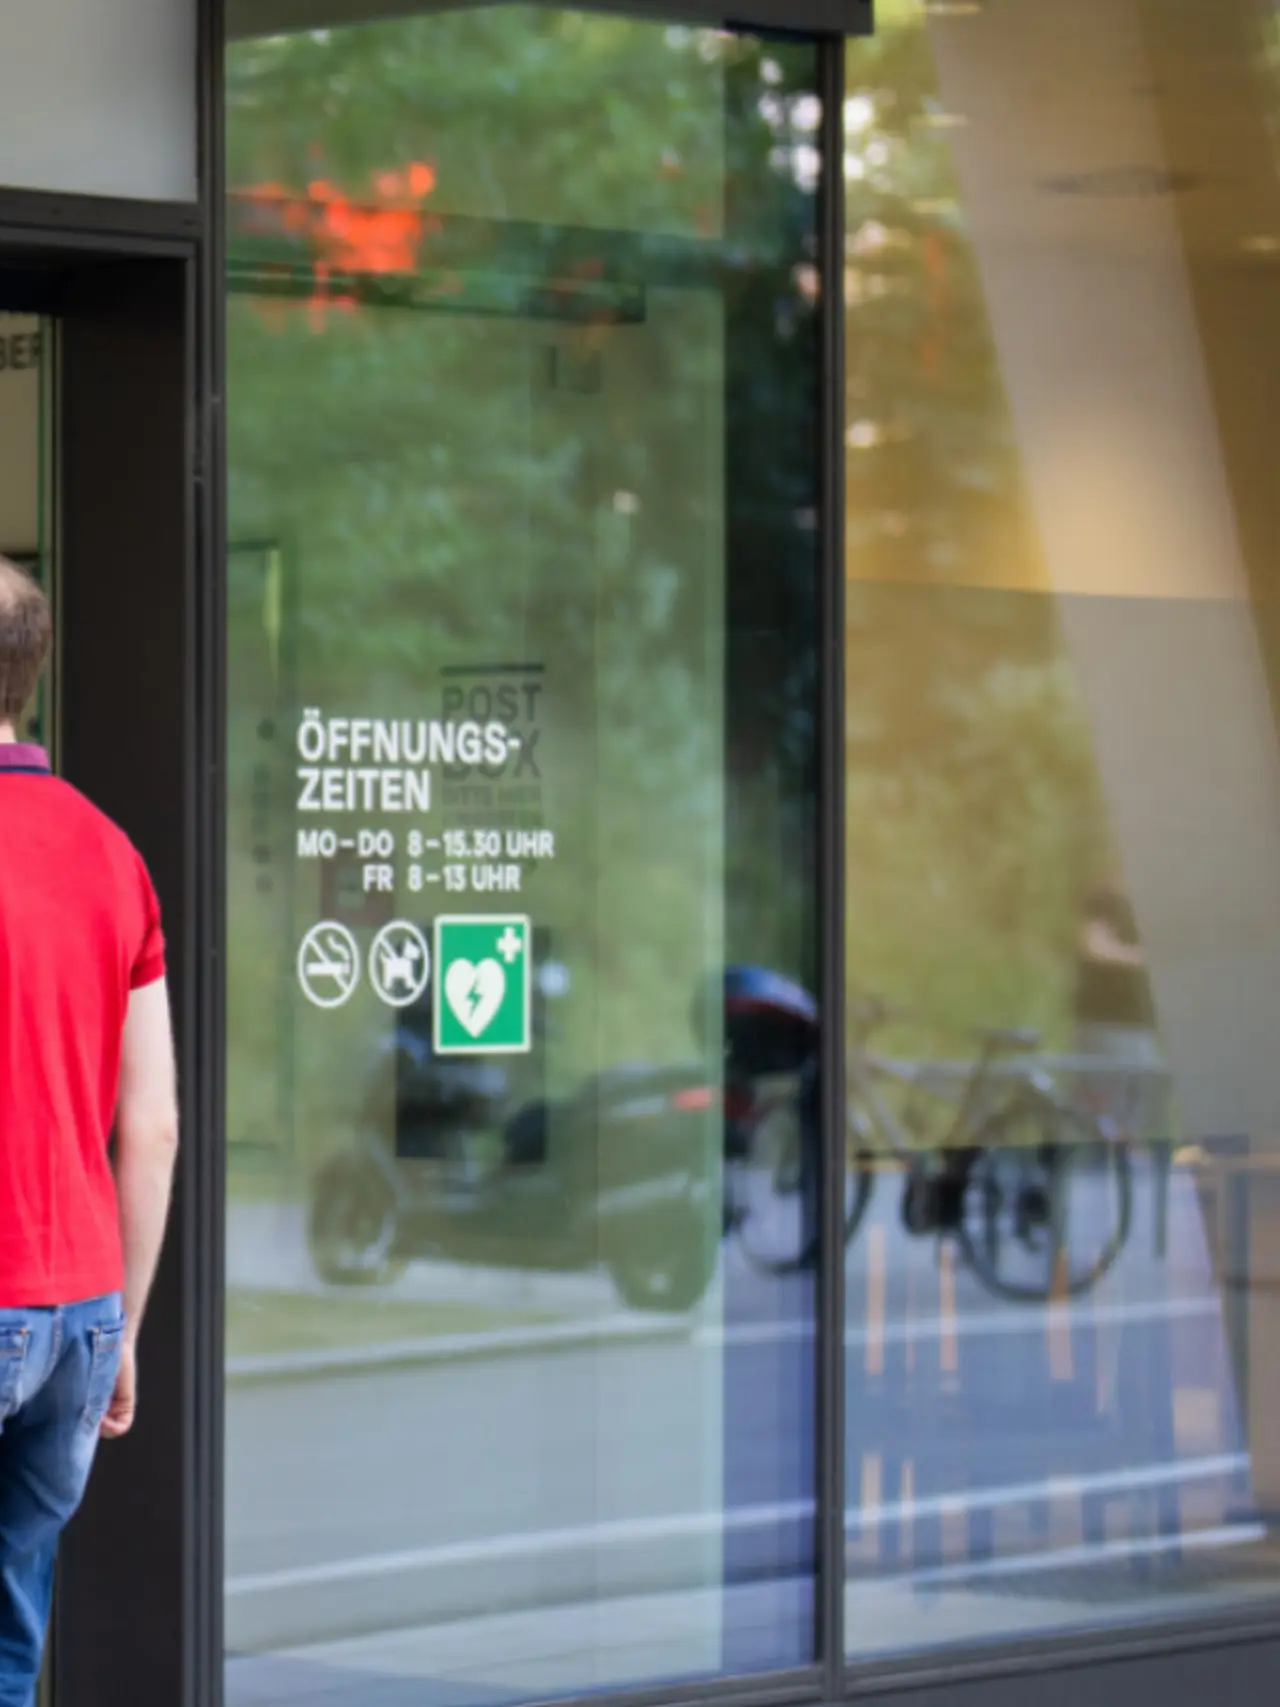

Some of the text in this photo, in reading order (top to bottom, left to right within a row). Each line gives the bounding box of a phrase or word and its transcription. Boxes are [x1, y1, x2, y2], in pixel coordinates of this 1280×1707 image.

[441, 683, 542, 724] POST
[296, 707, 522, 765] ÖFFNUNGS-
[296, 767, 431, 813] ZEITEN
[505, 829, 555, 858] UHR
[363, 864, 394, 892] FR
[471, 864, 521, 892] UHR
